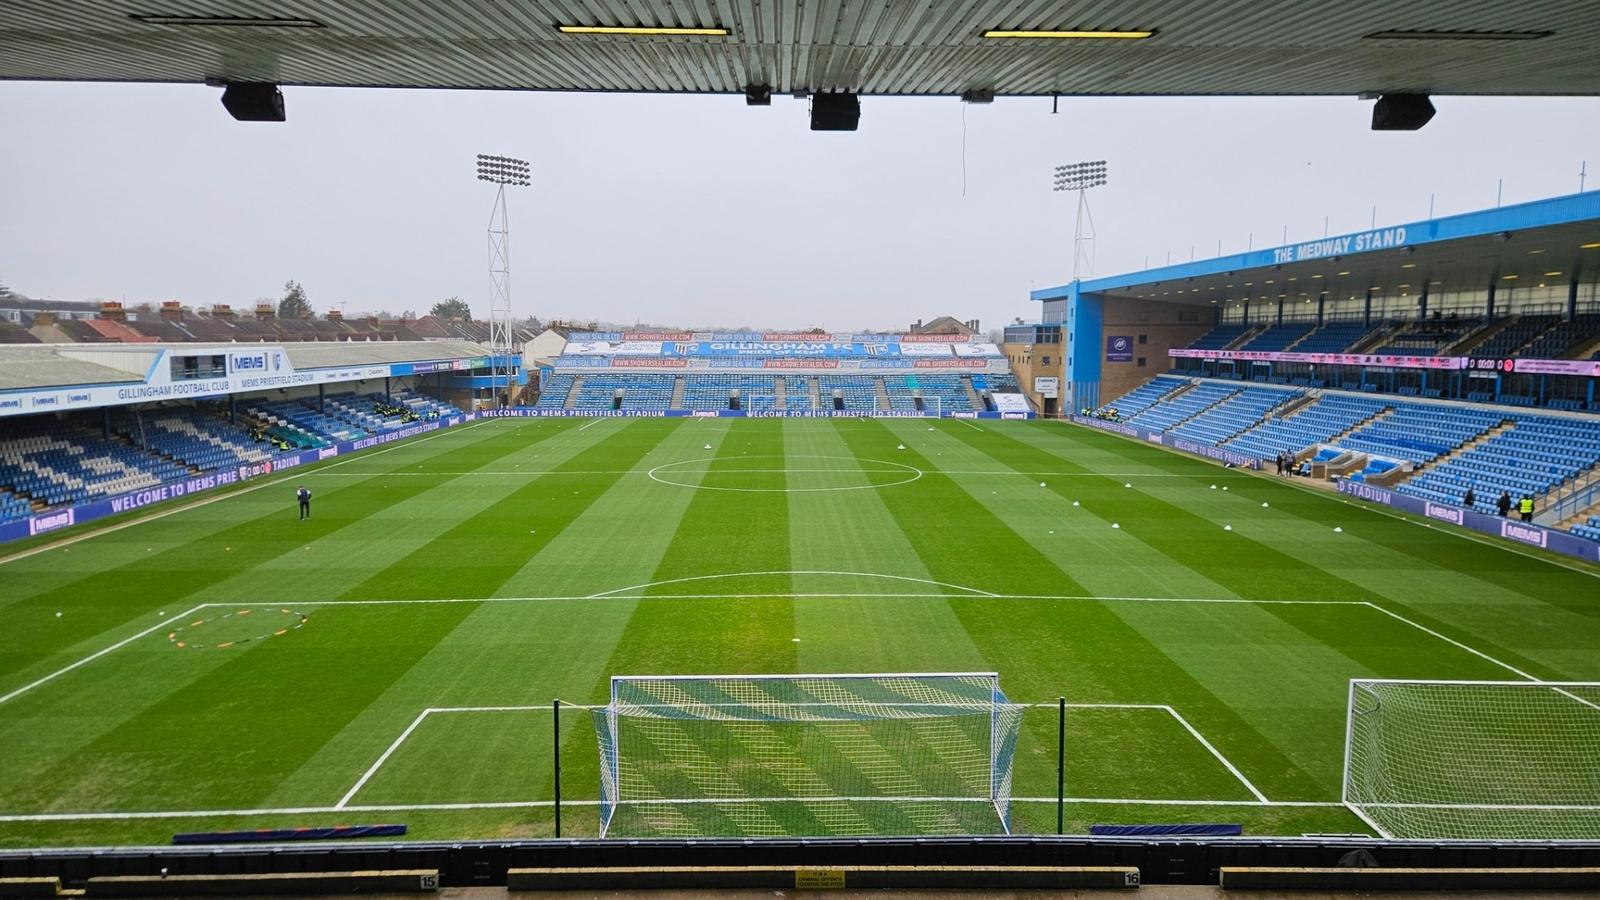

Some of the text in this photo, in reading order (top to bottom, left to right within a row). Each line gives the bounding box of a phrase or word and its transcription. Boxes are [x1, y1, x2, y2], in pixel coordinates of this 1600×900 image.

[1274, 228, 1406, 263] THE MEDWAY STAND
[234, 356, 263, 369] MEMS
[242, 373, 314, 387] MEMS PRIESTFIELD STADIUM
[118, 381, 230, 400] GILLINGHAM FOOTBALL CLUB
[353, 422, 440, 450] WELCOME TO MEMS PRIESTFIELD STADIUM
[1174, 440, 1198, 454] WELCOME
[1199, 446, 1206, 455] TO
[1207, 448, 1223, 460] MEMS
[273, 456, 300, 471] TADIUM
[112, 470, 236, 512] WELCOME TO MEMS PRIE
[1348, 482, 1391, 504] STADIUM
[36, 513, 68, 530] MEMS
[1430, 505, 1459, 521] MEMS
[1507, 525, 1541, 542] MEMS
[422, 876, 435, 887] 15
[1126, 874, 1139, 884] 16
